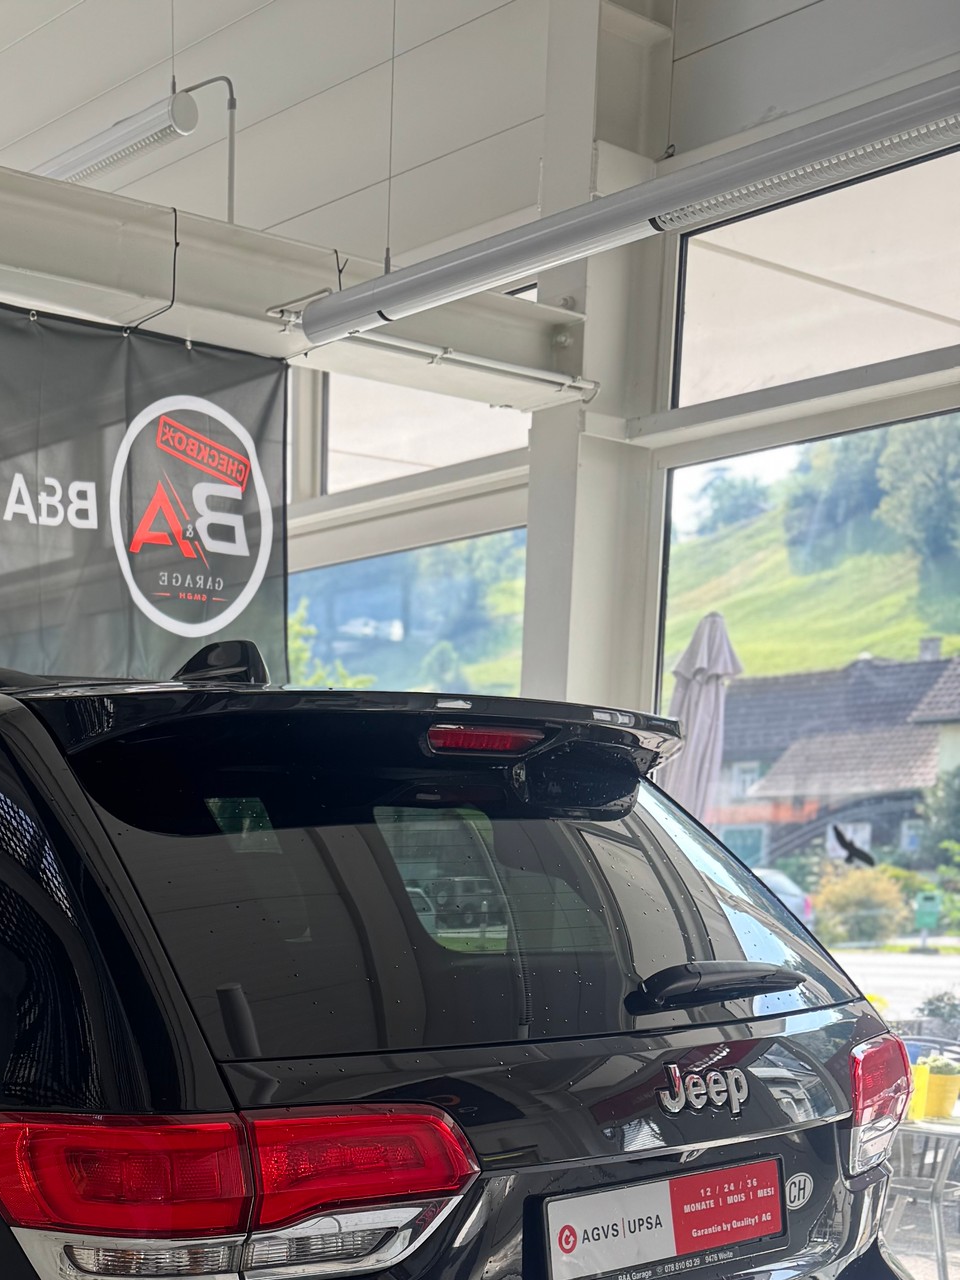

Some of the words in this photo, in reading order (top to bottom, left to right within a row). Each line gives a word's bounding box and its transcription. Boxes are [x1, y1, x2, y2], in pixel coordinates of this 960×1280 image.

[655, 1062, 749, 1115] Jeep
[683, 1199, 715, 1213] MONATE
[727, 1193, 746, 1204] MOIS
[757, 1187, 774, 1198] MESI
[700, 1188, 711, 1197] 12
[724, 1183, 735, 1192] 24
[747, 1178, 758, 1187] 36
[788, 1178, 807, 1204] CH
[581, 1222, 620, 1244] AGVS
[627, 1214, 663, 1234] UPSA
[691, 1225, 721, 1237] Garantie
[722, 1222, 731, 1231] by
[732, 1215, 759, 1229] Quality1
[761, 1212, 772, 1221] AG
[631, 1270, 652, 1280] Garage
[664, 1263, 675, 1273] 078
